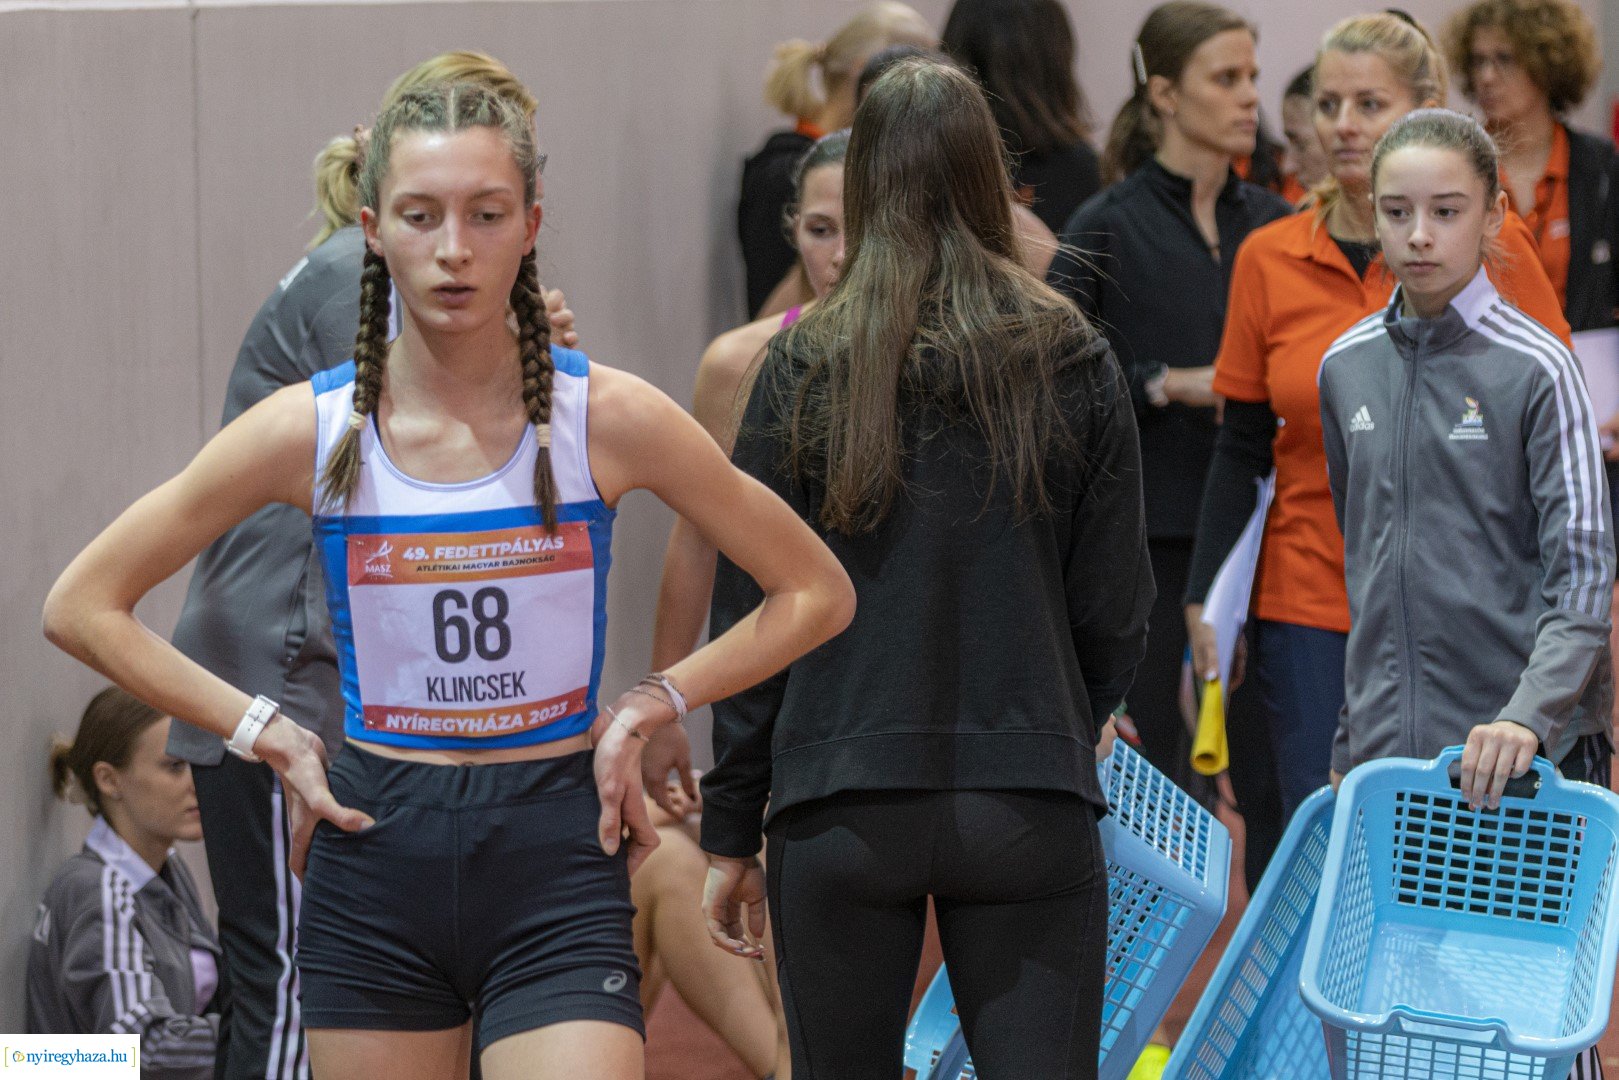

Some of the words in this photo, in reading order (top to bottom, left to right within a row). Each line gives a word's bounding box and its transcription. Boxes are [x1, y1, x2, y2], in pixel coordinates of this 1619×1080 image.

[403, 546, 430, 561] 49.
[434, 536, 564, 560] FEDETTPÁLYÁS
[365, 564, 392, 573] MASZ
[416, 563, 460, 573] ATLÉTIKAI
[462, 561, 500, 571] MAGYAR
[502, 555, 555, 567] BAJNOKSÁG
[432, 586, 512, 664] 68
[426, 671, 527, 703] KLINCSEK
[386, 713, 524, 733] NYÍREGYHÁZA
[528, 701, 568, 725] 2023
